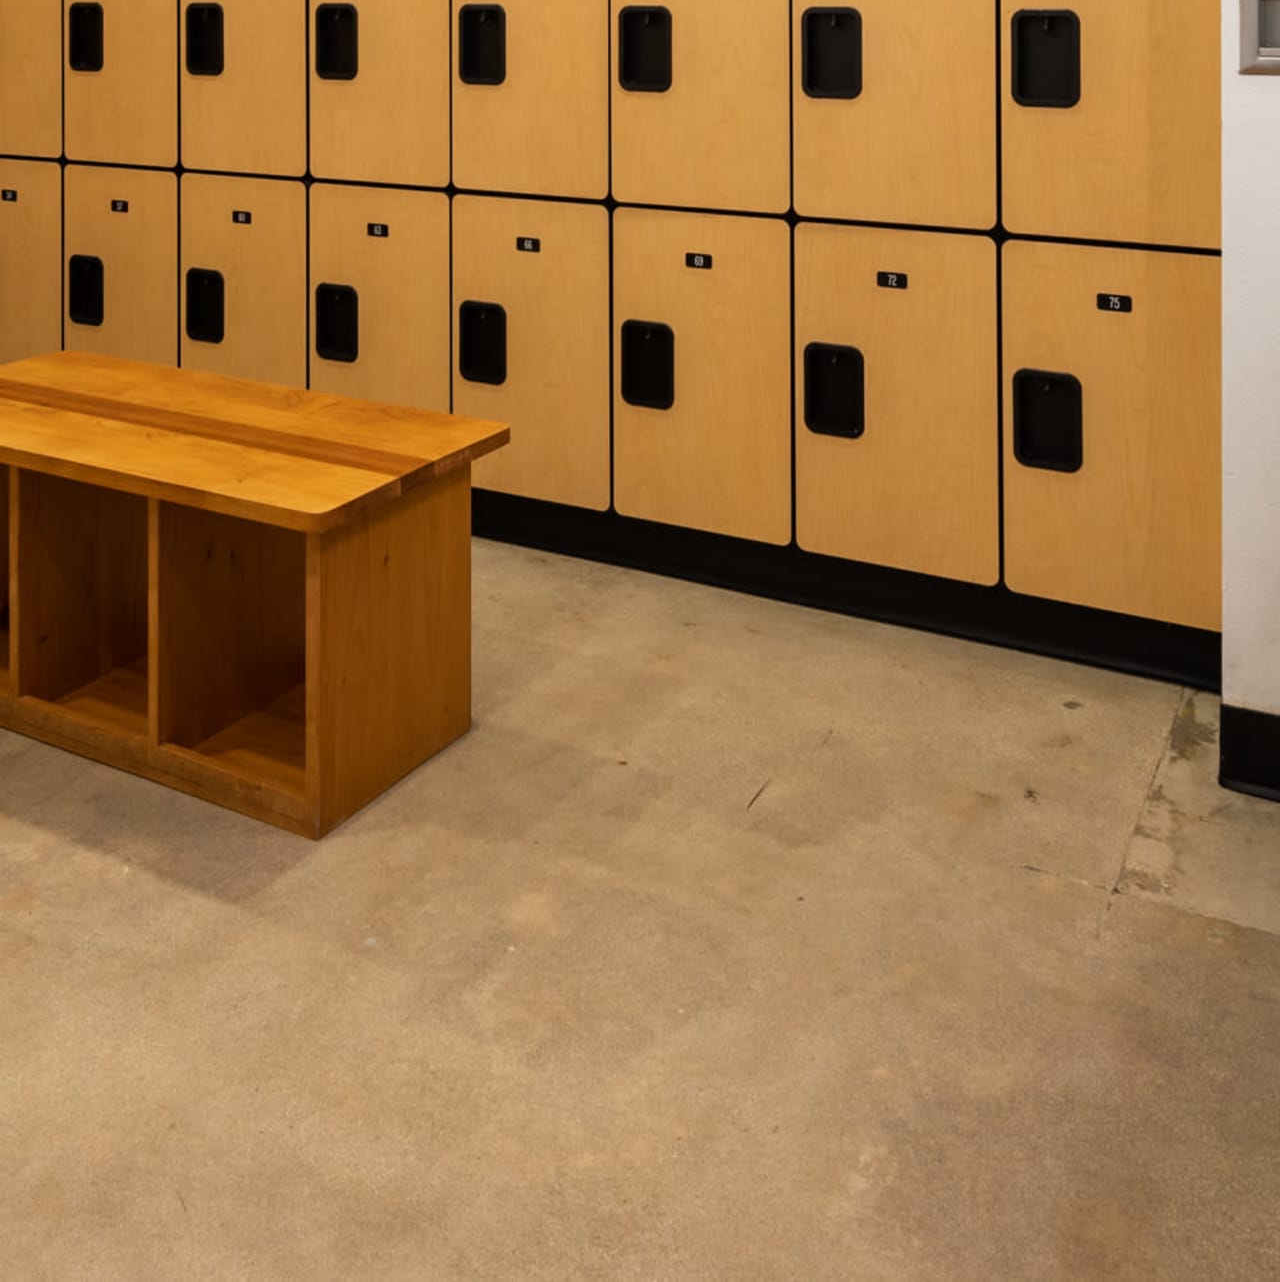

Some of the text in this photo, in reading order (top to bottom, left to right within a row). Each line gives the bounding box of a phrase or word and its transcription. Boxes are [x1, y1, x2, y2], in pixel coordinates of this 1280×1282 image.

[693, 255, 704, 267] 69
[887, 273, 898, 287] 72
[1108, 295, 1121, 310] 75
